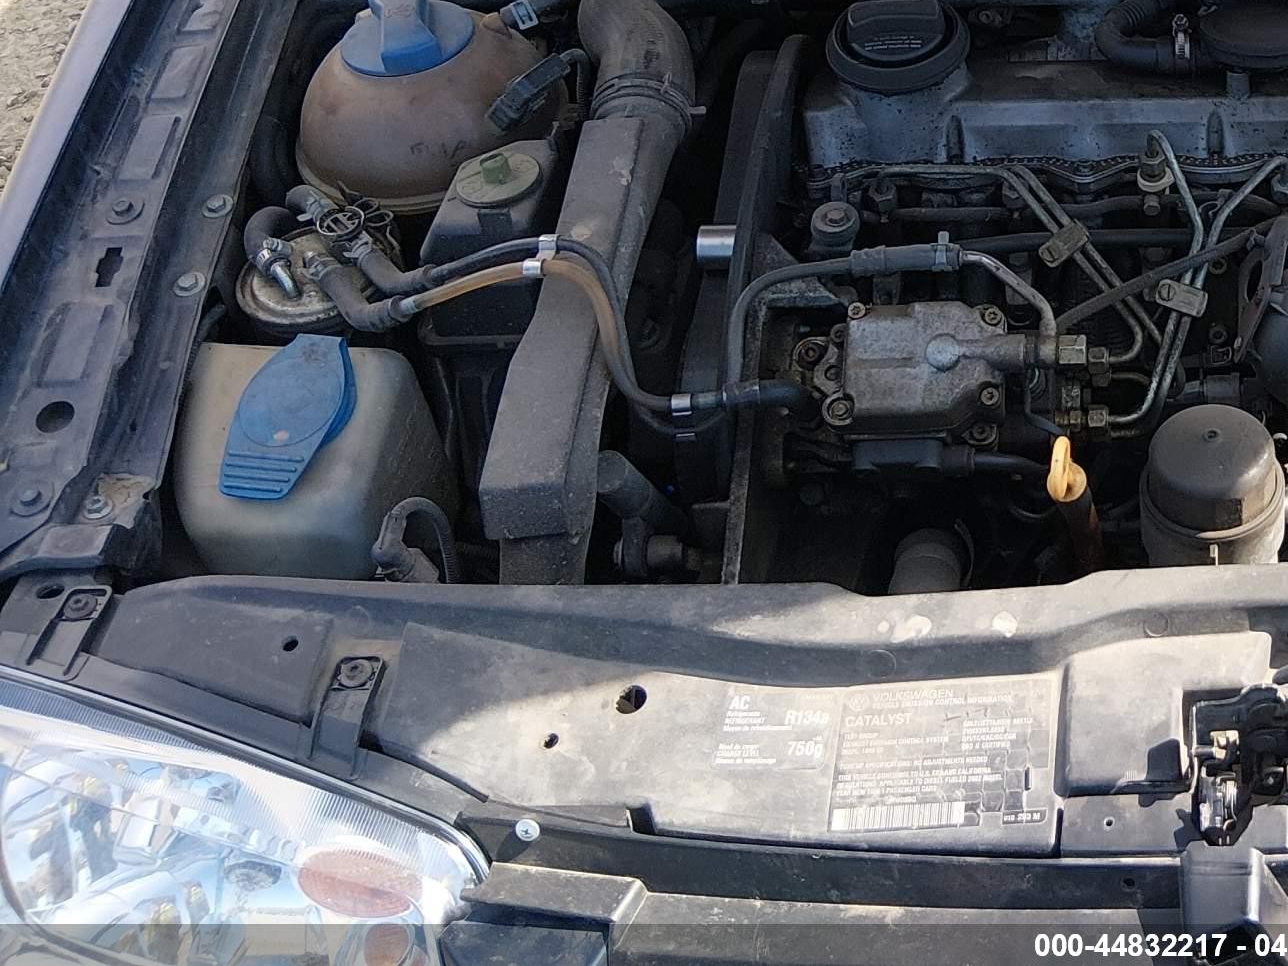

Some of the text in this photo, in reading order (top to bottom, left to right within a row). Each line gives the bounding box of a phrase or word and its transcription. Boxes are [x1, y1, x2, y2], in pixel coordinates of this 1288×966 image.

[872, 688, 953, 701] VOLKSWAGEN
[729, 695, 751, 710] AC
[844, 712, 913, 727] CATALYST
[787, 741, 824, 758] 750g
[1032, 812, 1040, 820] M
